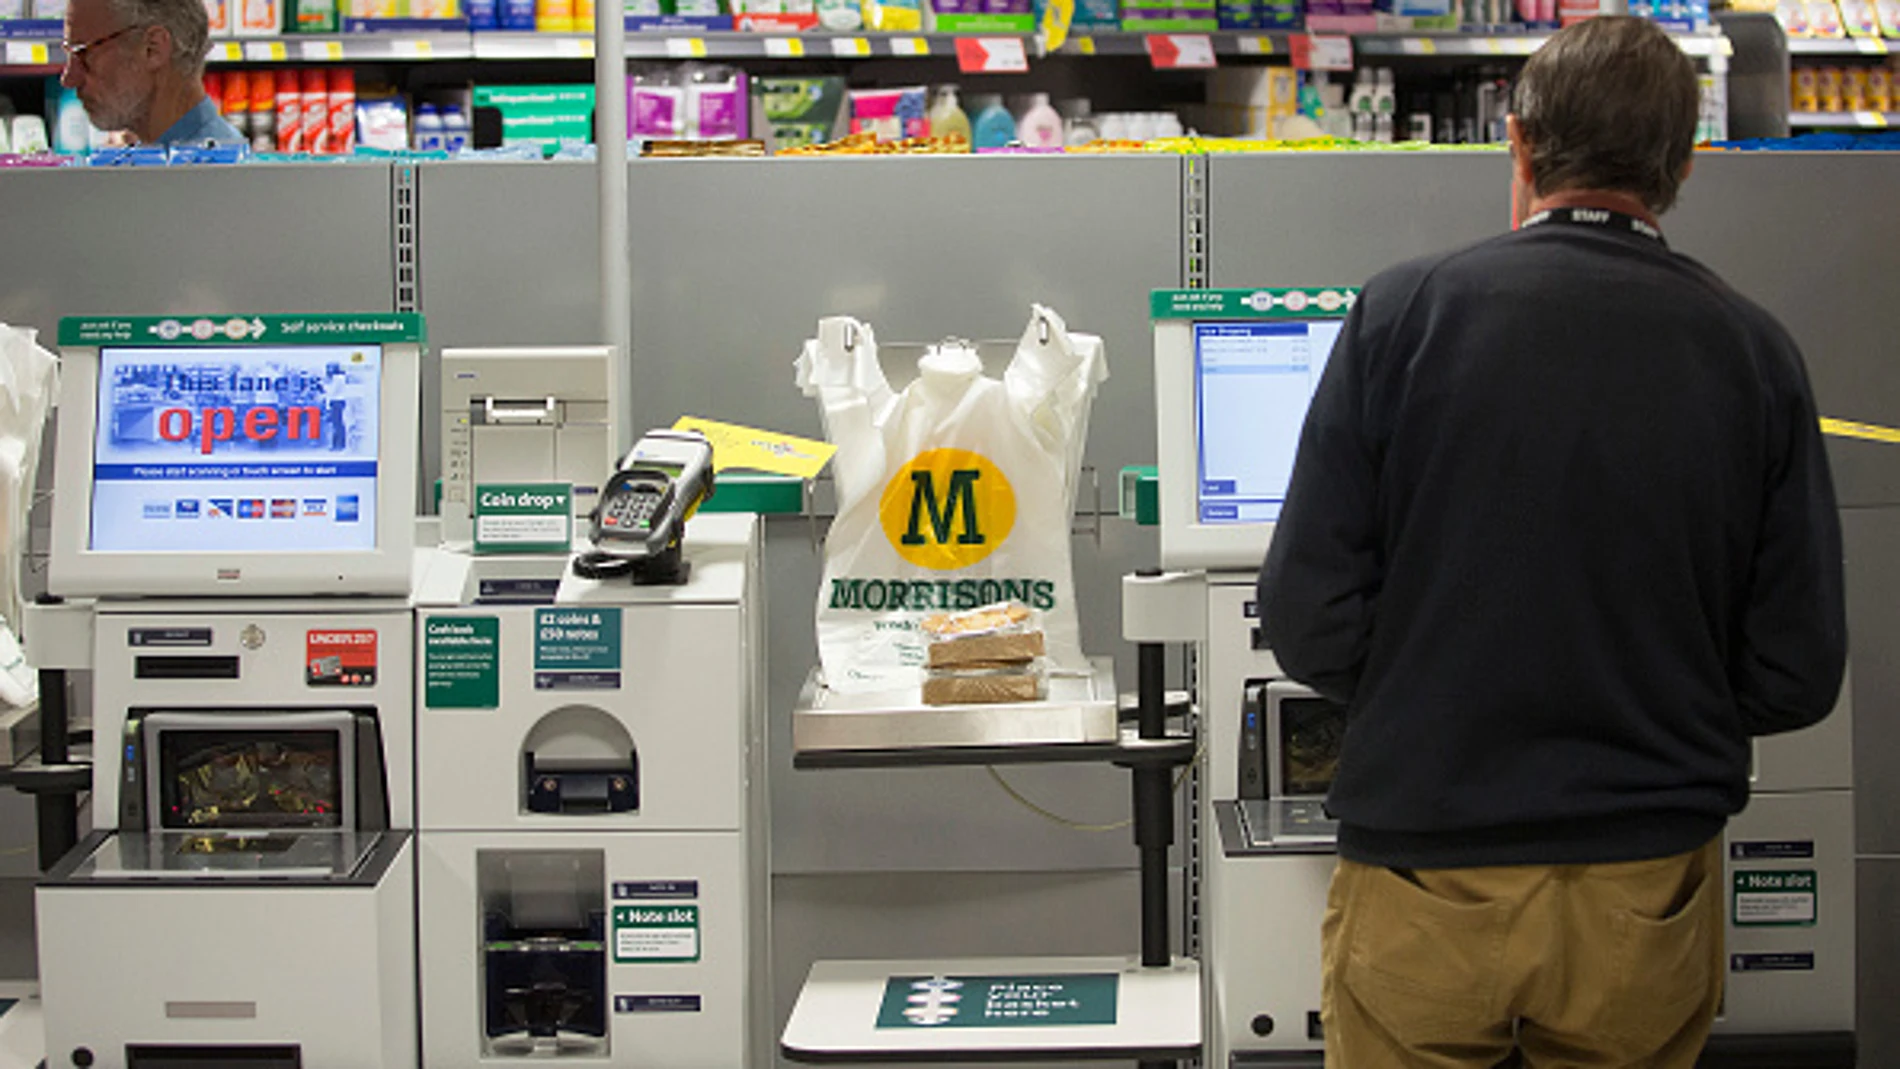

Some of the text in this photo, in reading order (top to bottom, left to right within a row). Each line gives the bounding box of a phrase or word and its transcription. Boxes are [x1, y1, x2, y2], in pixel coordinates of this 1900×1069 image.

[1572, 208, 1610, 222] STAFF
[280, 319, 304, 334] Self
[228, 372, 289, 392] lane
[158, 405, 321, 455] open
[481, 492, 554, 510] Coin drop
[901, 469, 985, 545] M
[828, 578, 1055, 611] MORRISONS
[1748, 874, 1782, 888] Note
[628, 908, 696, 923] Note slot
[987, 991, 1053, 999] your
[990, 983, 1063, 993] Place
[986, 999, 1080, 1009] basket
